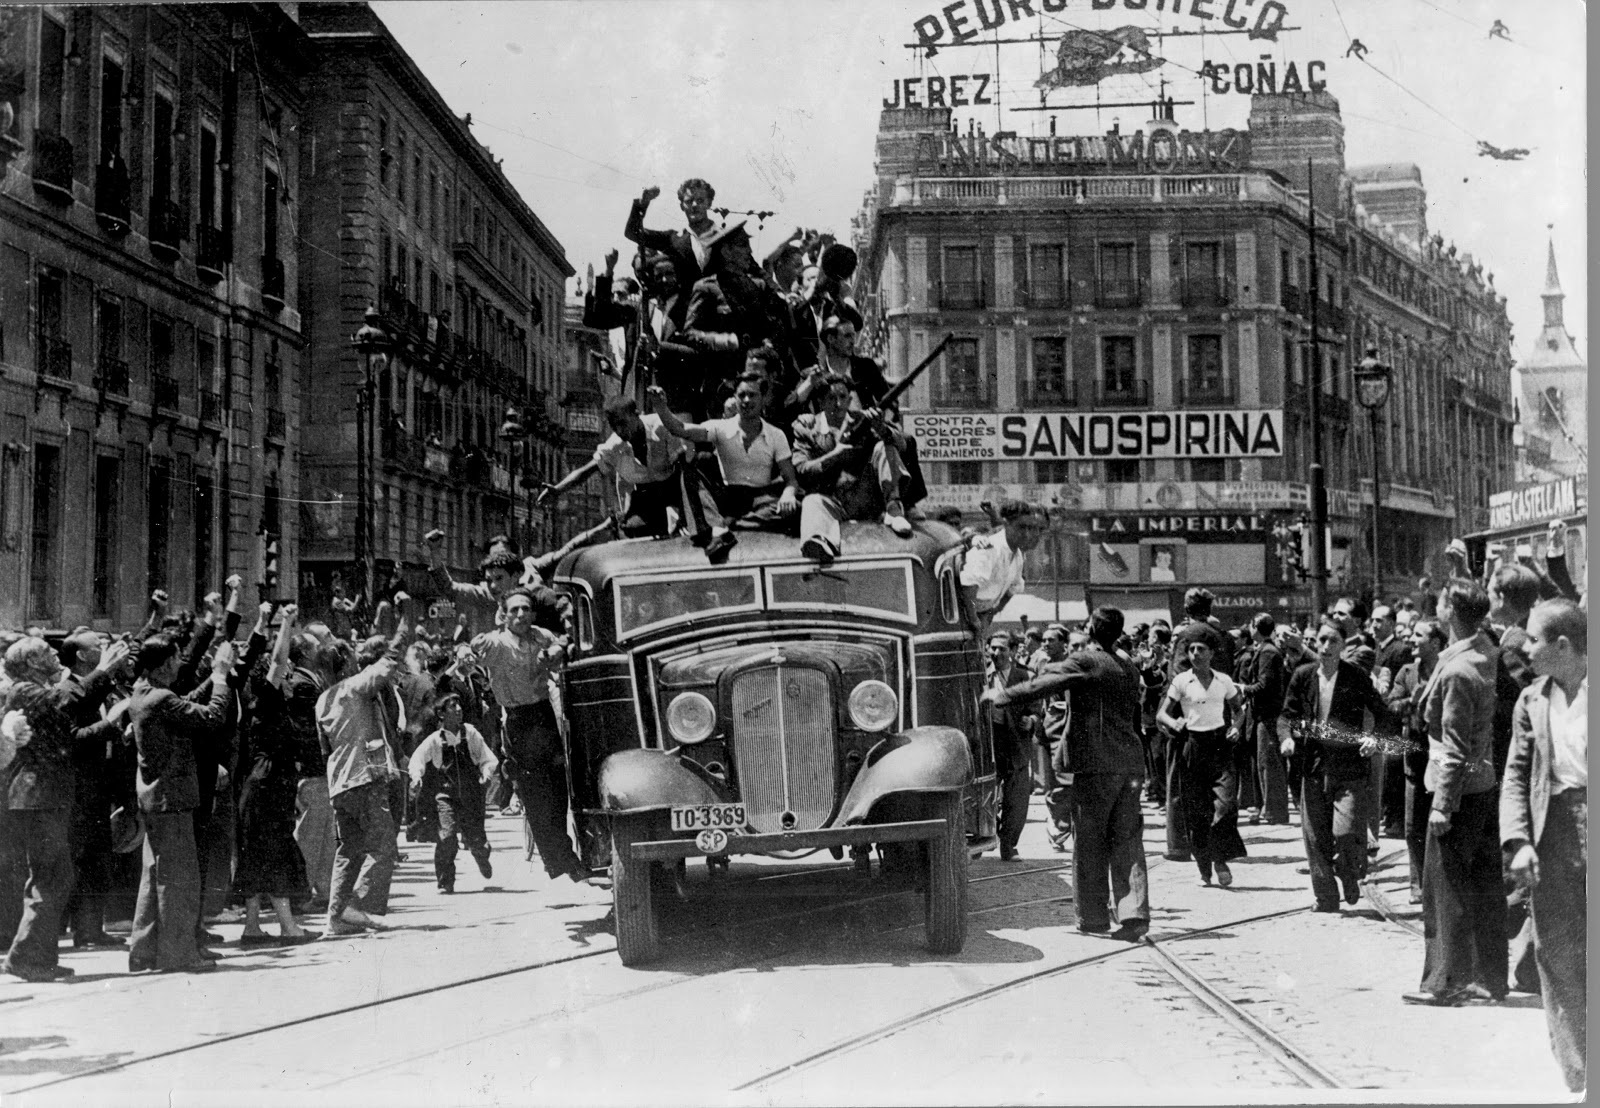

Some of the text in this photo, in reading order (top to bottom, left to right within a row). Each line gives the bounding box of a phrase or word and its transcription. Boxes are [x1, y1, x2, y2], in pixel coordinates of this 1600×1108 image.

[1092, 0, 1289, 42] ECQ
[883, 54, 1326, 109] JEREZ COÑAC
[916, 130, 1019, 176] ANIS
[914, 416, 987, 426] CONTRA
[915, 427, 996, 437] DOLORES
[1002, 412, 1282, 457] SANOSPIRINA
[927, 437, 983, 447] GRIPE
[917, 448, 994, 458] NFRIAMIENTOS
[1512, 478, 1575, 522] CASTELLANA
[1092, 516, 1264, 532] LA IMPERIAL
[1212, 597, 1263, 607] ALZADOS
[673, 806, 745, 828] TO-3369
[701, 832, 724, 851] SP
